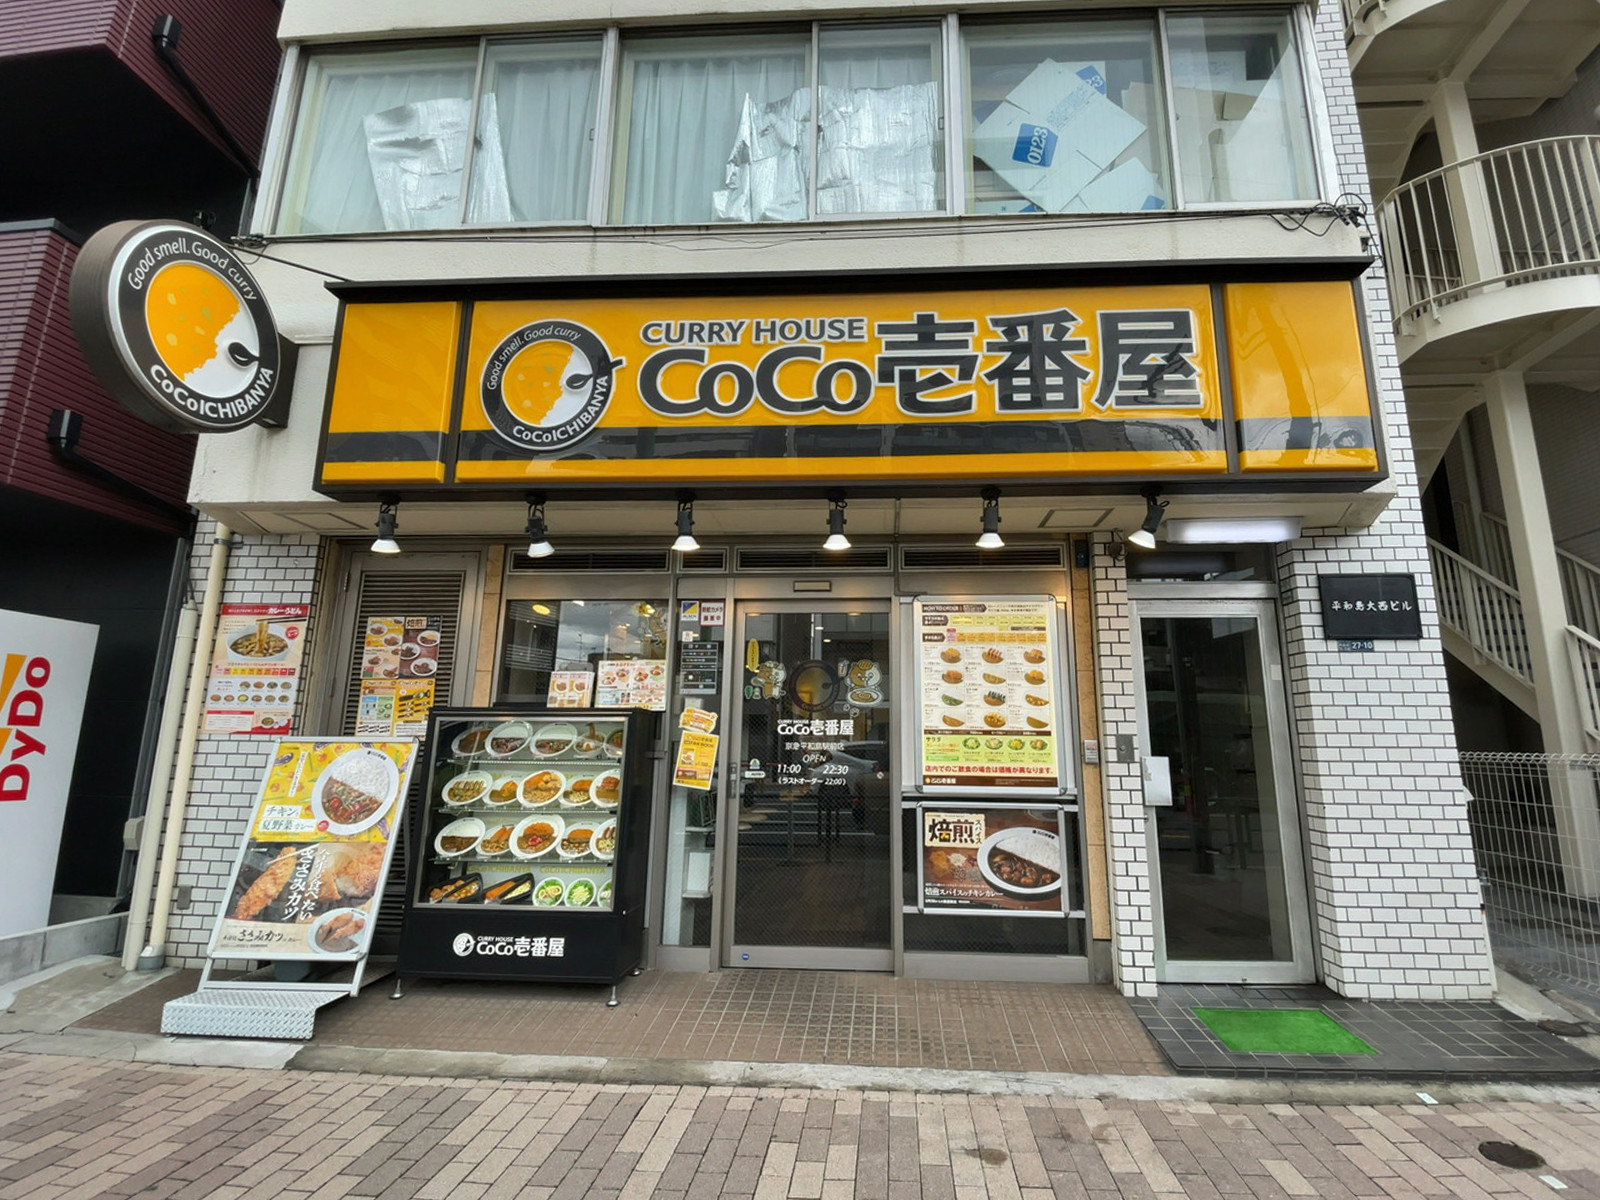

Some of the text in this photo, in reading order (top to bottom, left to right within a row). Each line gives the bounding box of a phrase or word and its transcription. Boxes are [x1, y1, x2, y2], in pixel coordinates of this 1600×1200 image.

[1027, 127, 1048, 164] 0123
[127, 237, 257, 301] Good smell. Good curry
[640, 317, 867, 344] CURRY HOUSE
[486, 325, 582, 391] Good smell. Good curry
[638, 308, 1203, 417] CoCo壱番屋
[149, 365, 274, 419] CoCoICHIBANYA
[512, 375, 609, 443] CoCoICHIBANYA
[1331, 600, 1412, 612] 平和島大西ビル
[1351, 641, 1373, 649] 27-10
[0, 656, 51, 801] DyDo
[777, 764, 801, 774] 11:00
[822, 764, 849, 775] 22:30
[802, 754, 827, 763] OPEN
[928, 818, 973, 844] 焙煎
[280, 846, 316, 921] ささみカツ
[476, 936, 565, 957] CoCo壱番屋
